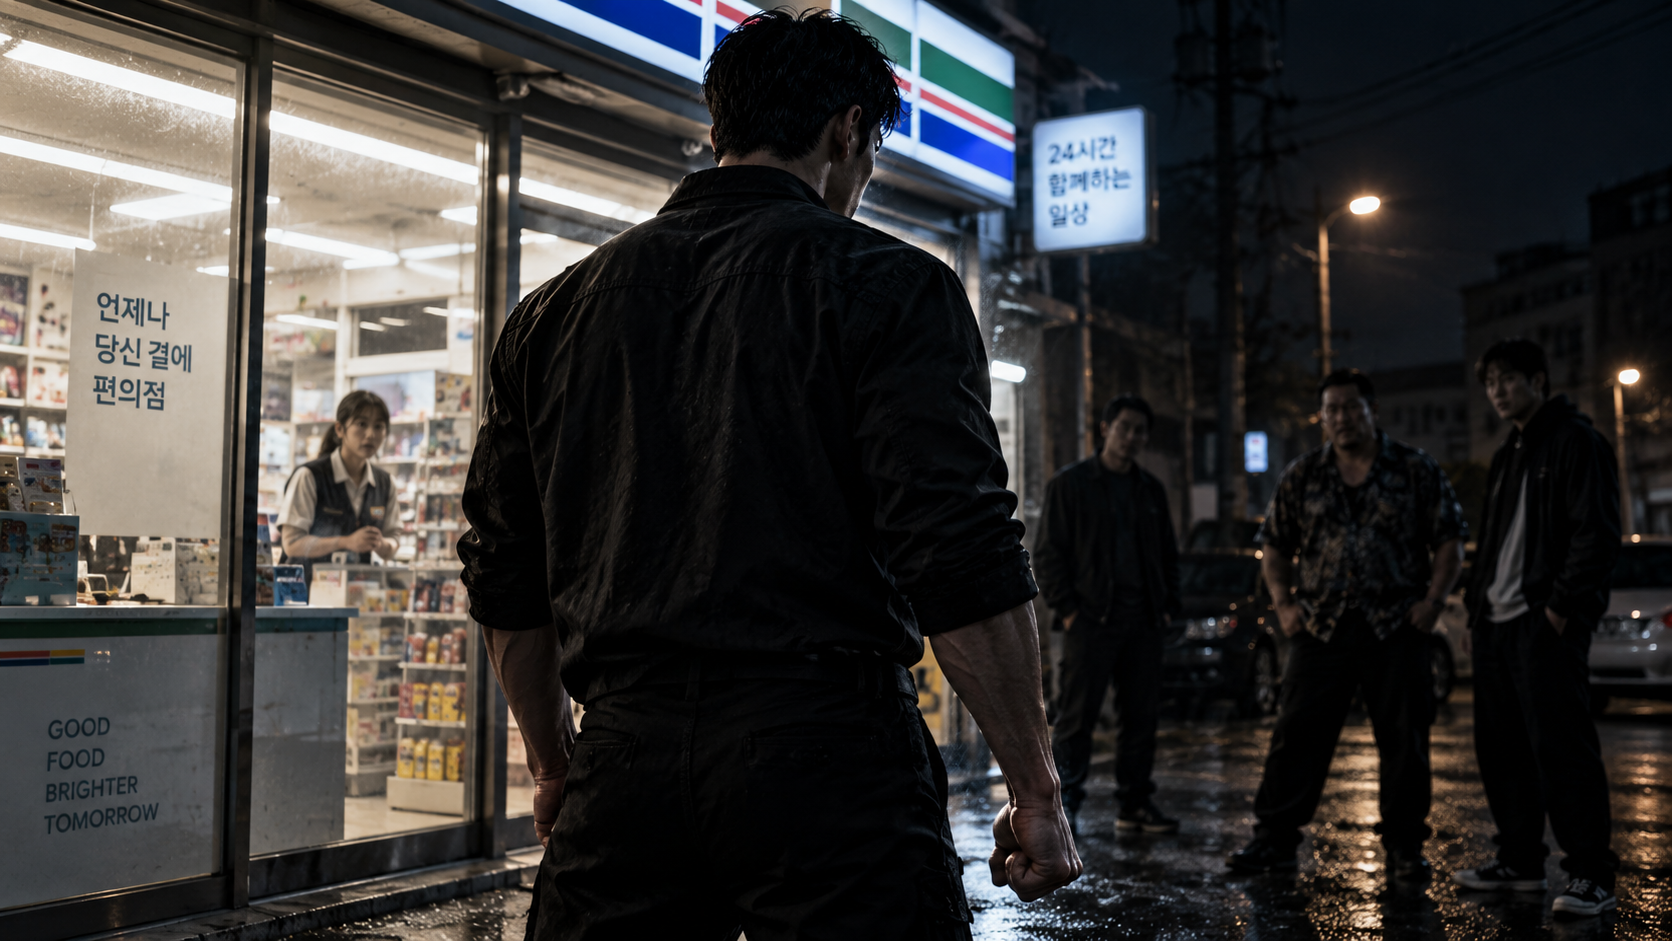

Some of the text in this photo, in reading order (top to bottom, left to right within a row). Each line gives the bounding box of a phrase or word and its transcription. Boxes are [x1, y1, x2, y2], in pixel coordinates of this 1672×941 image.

[1048, 135, 1116, 165] 24시간
[1048, 167, 1131, 197] 함께하는
[1048, 202, 1088, 228] 일상
[97, 292, 170, 330] 언제나
[95, 333, 141, 367] 당신
[93, 375, 165, 411] 편의점
[48, 717, 110, 740] GOOD
[47, 748, 105, 772] FOOD
[45, 776, 138, 803] BRIGHTER
[44, 803, 159, 834] TOMORROW
